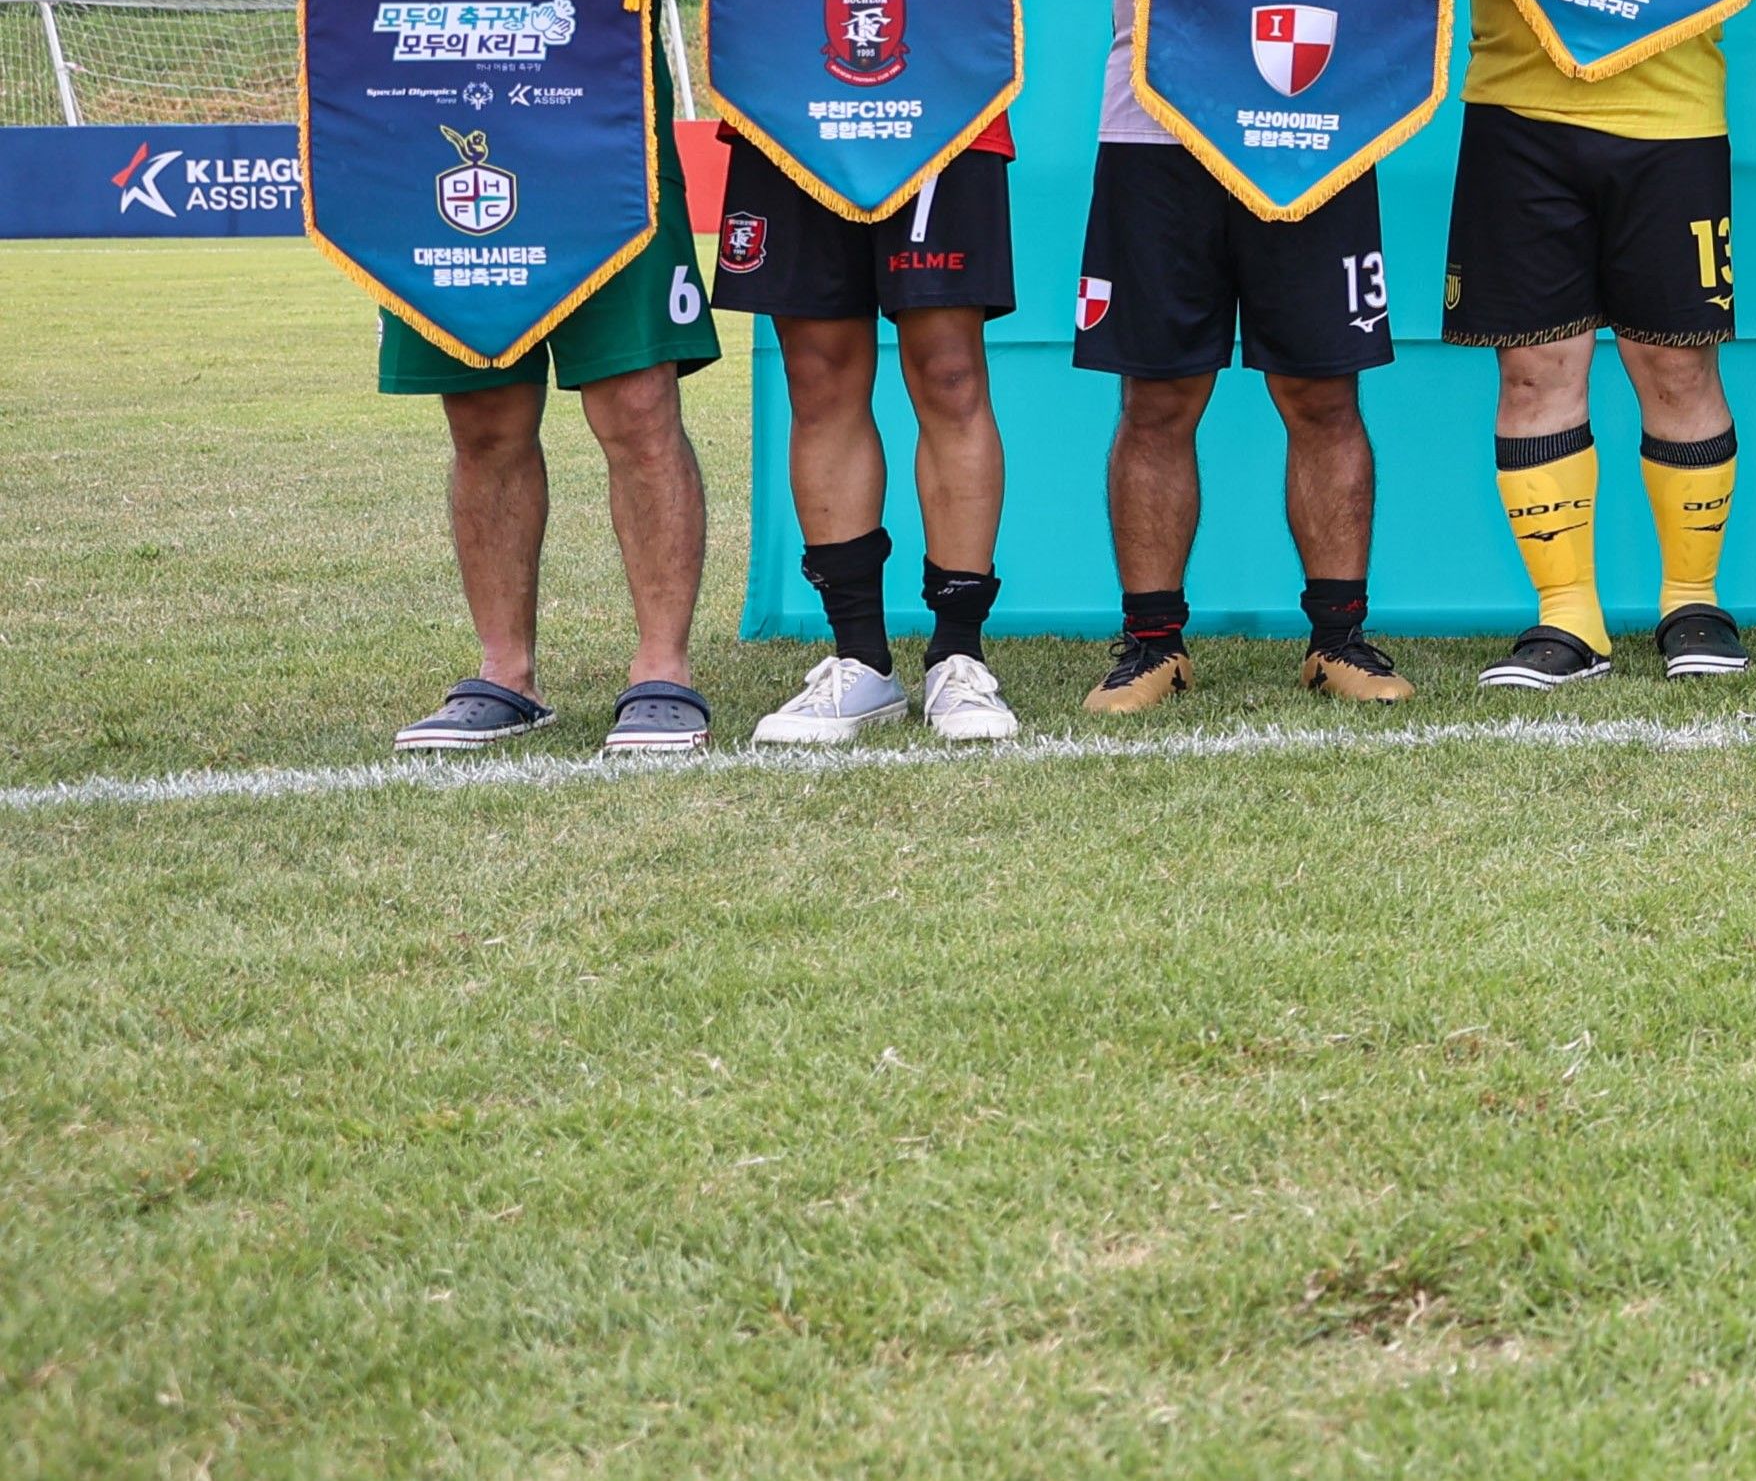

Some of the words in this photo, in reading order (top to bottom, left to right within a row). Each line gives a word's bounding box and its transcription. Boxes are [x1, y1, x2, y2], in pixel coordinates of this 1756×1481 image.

[378, 6, 447, 30] 모두의
[458, 7, 529, 30] 축구장
[398, 34, 468, 55] 모두의
[477, 33, 541, 55] K리그
[367, 88, 405, 96] Special
[408, 88, 457, 96] Olympics
[545, 88, 583, 96] LEAGUE
[808, 101, 922, 118] 부천FC1995
[1237, 111, 1339, 130] 부산아이파크
[820, 122, 912, 139] 통합축구단
[1244, 132, 1329, 149] 통합축구단
[187, 160, 210, 183] K
[217, 159, 304, 183] LEAGU
[187, 186, 298, 210] ASSIST
[414, 248, 546, 265] 대전하나시티즌
[433, 268, 528, 286] 통합축구단
[1343, 251, 1387, 313] 13
[668, 266, 700, 324] 6
